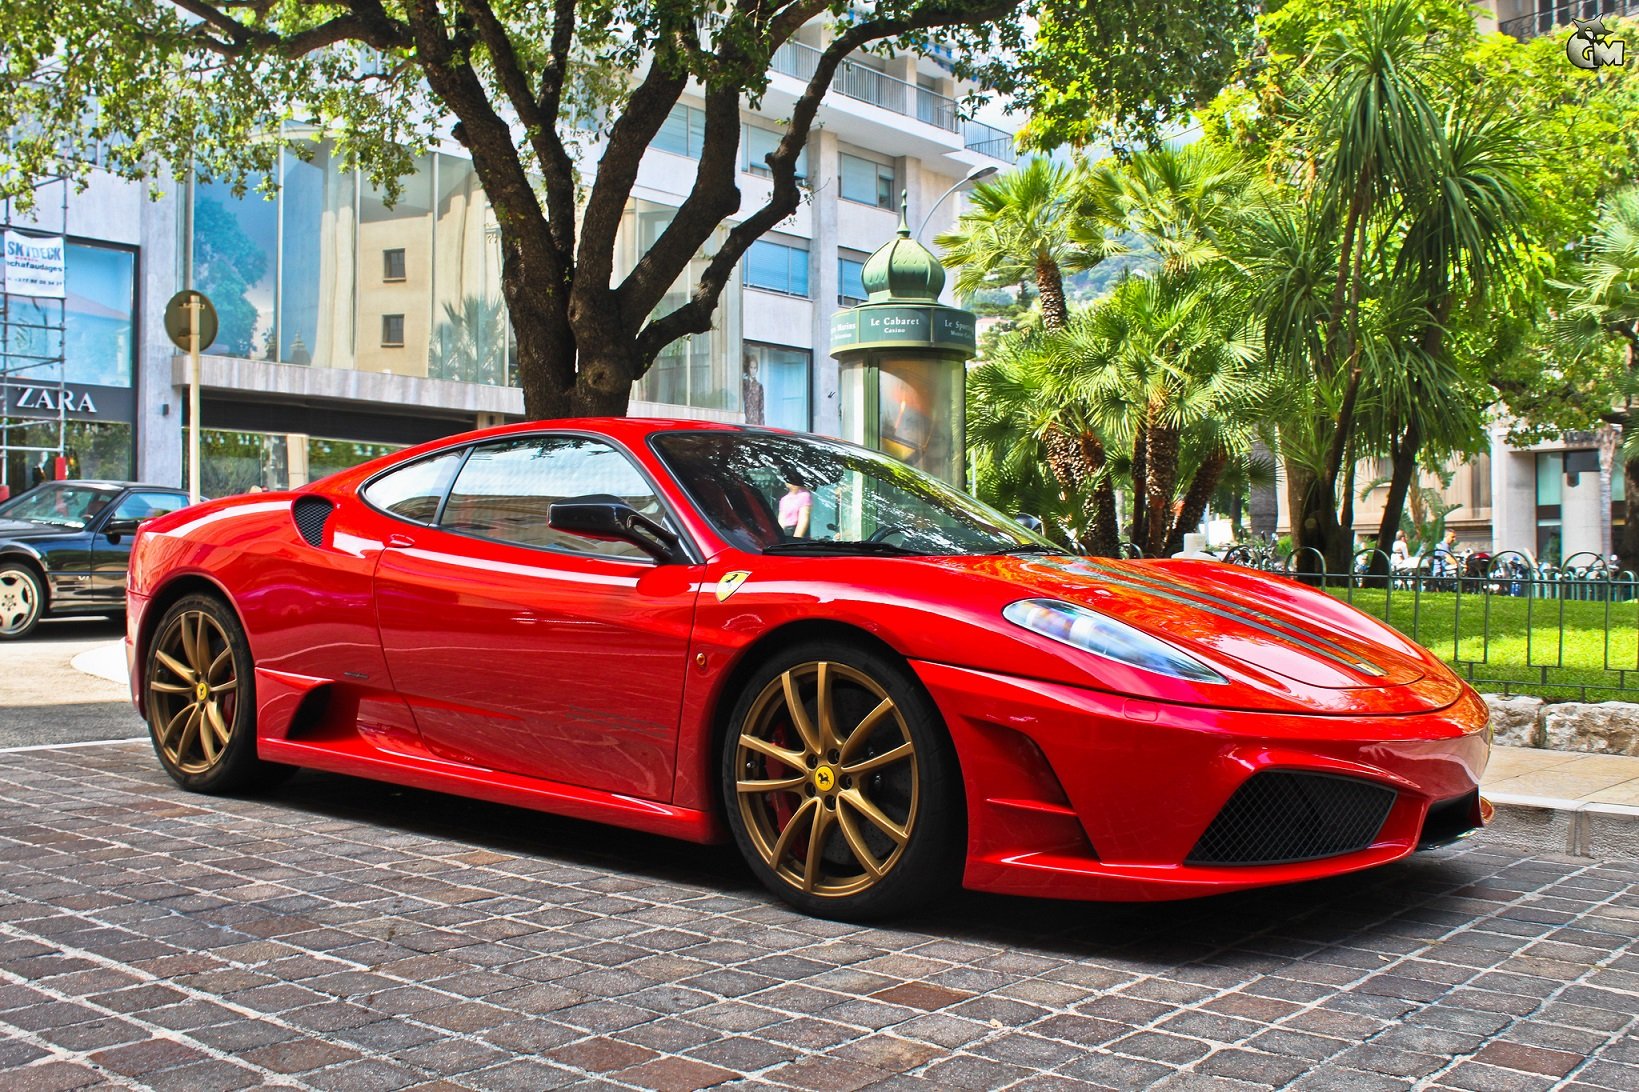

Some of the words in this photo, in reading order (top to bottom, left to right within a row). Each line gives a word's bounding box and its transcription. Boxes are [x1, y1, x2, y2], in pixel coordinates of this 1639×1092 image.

[7, 240, 61, 261] SKYDECK
[870, 318, 880, 326] Le
[883, 316, 919, 326] Cabaret
[945, 319, 953, 327] Le
[16, 387, 97, 413] ZARA
